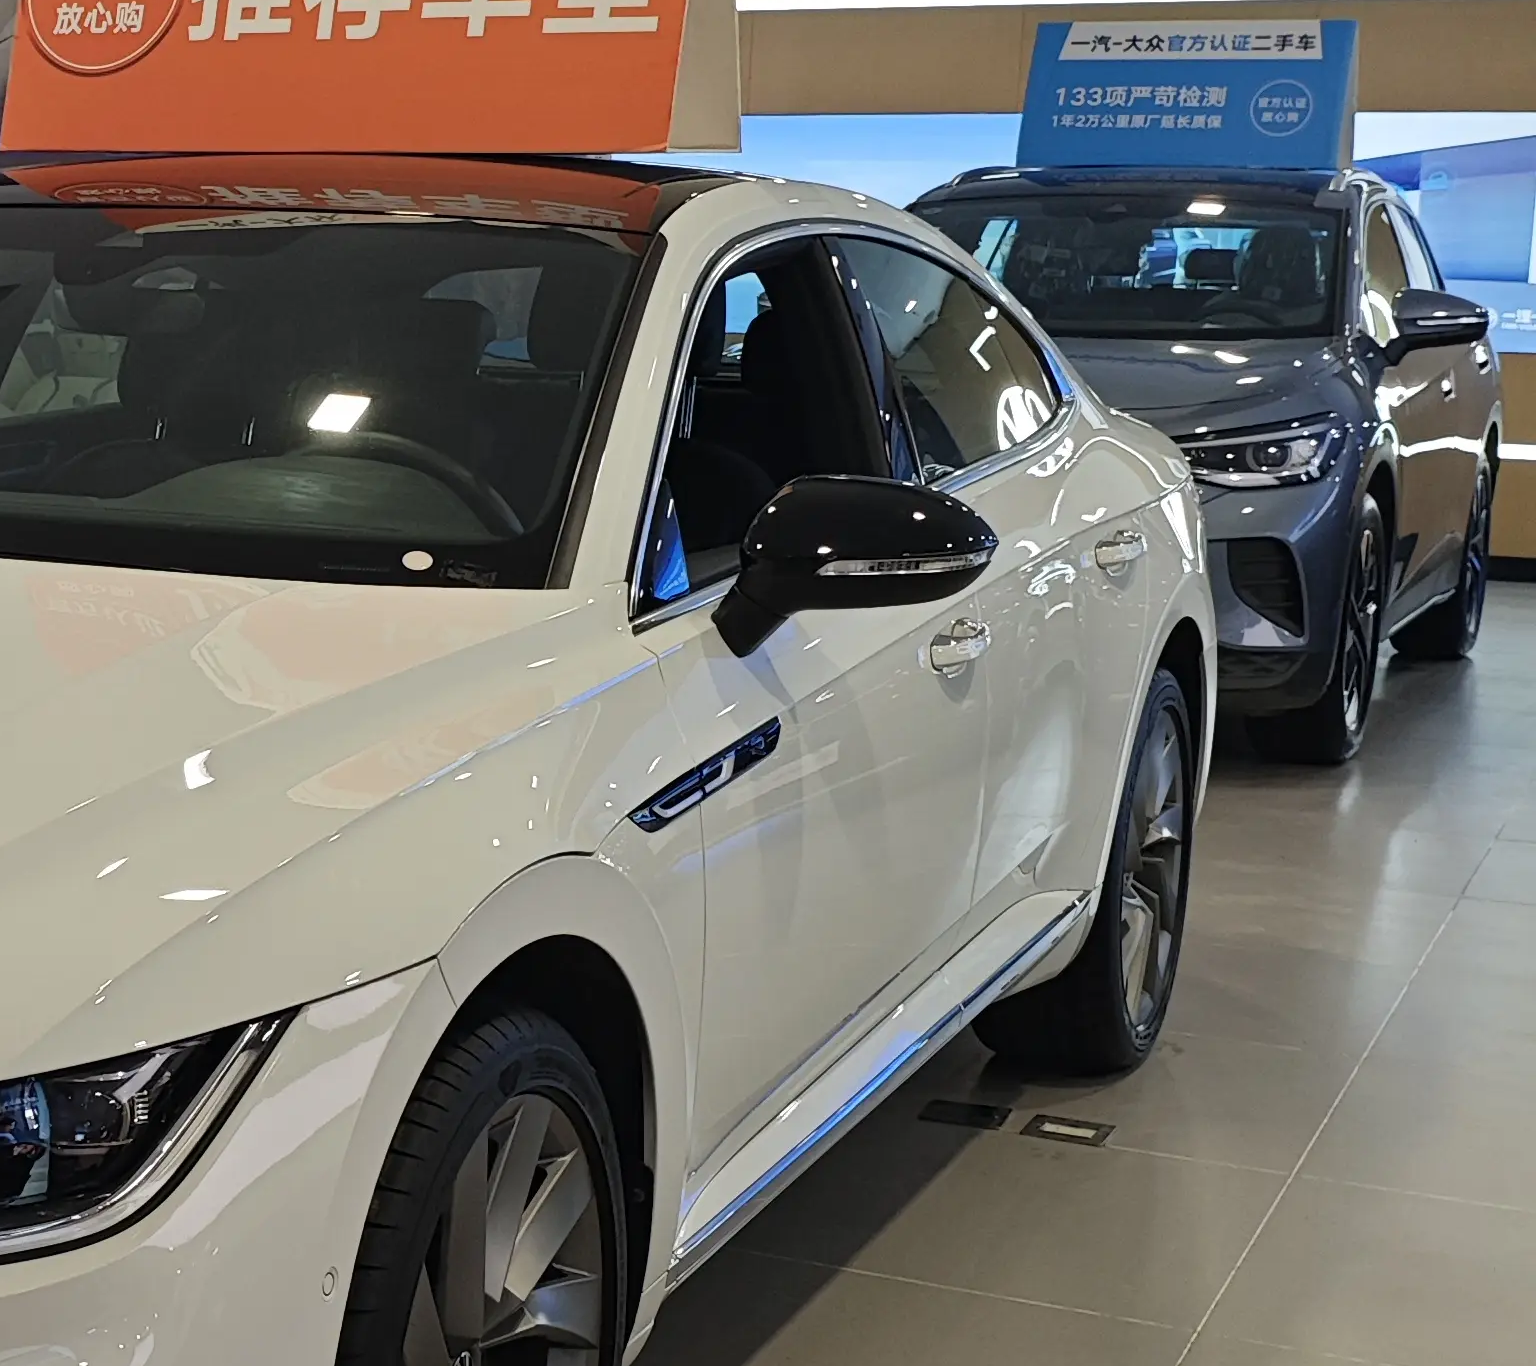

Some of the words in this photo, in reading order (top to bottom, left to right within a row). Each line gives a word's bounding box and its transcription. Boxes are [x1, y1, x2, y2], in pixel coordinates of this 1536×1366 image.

[53, 1, 145, 36] 放心购
[1071, 34, 1316, 53] 一汽-大众官方认证二手车
[1056, 86, 1227, 107] 133项严苛检测
